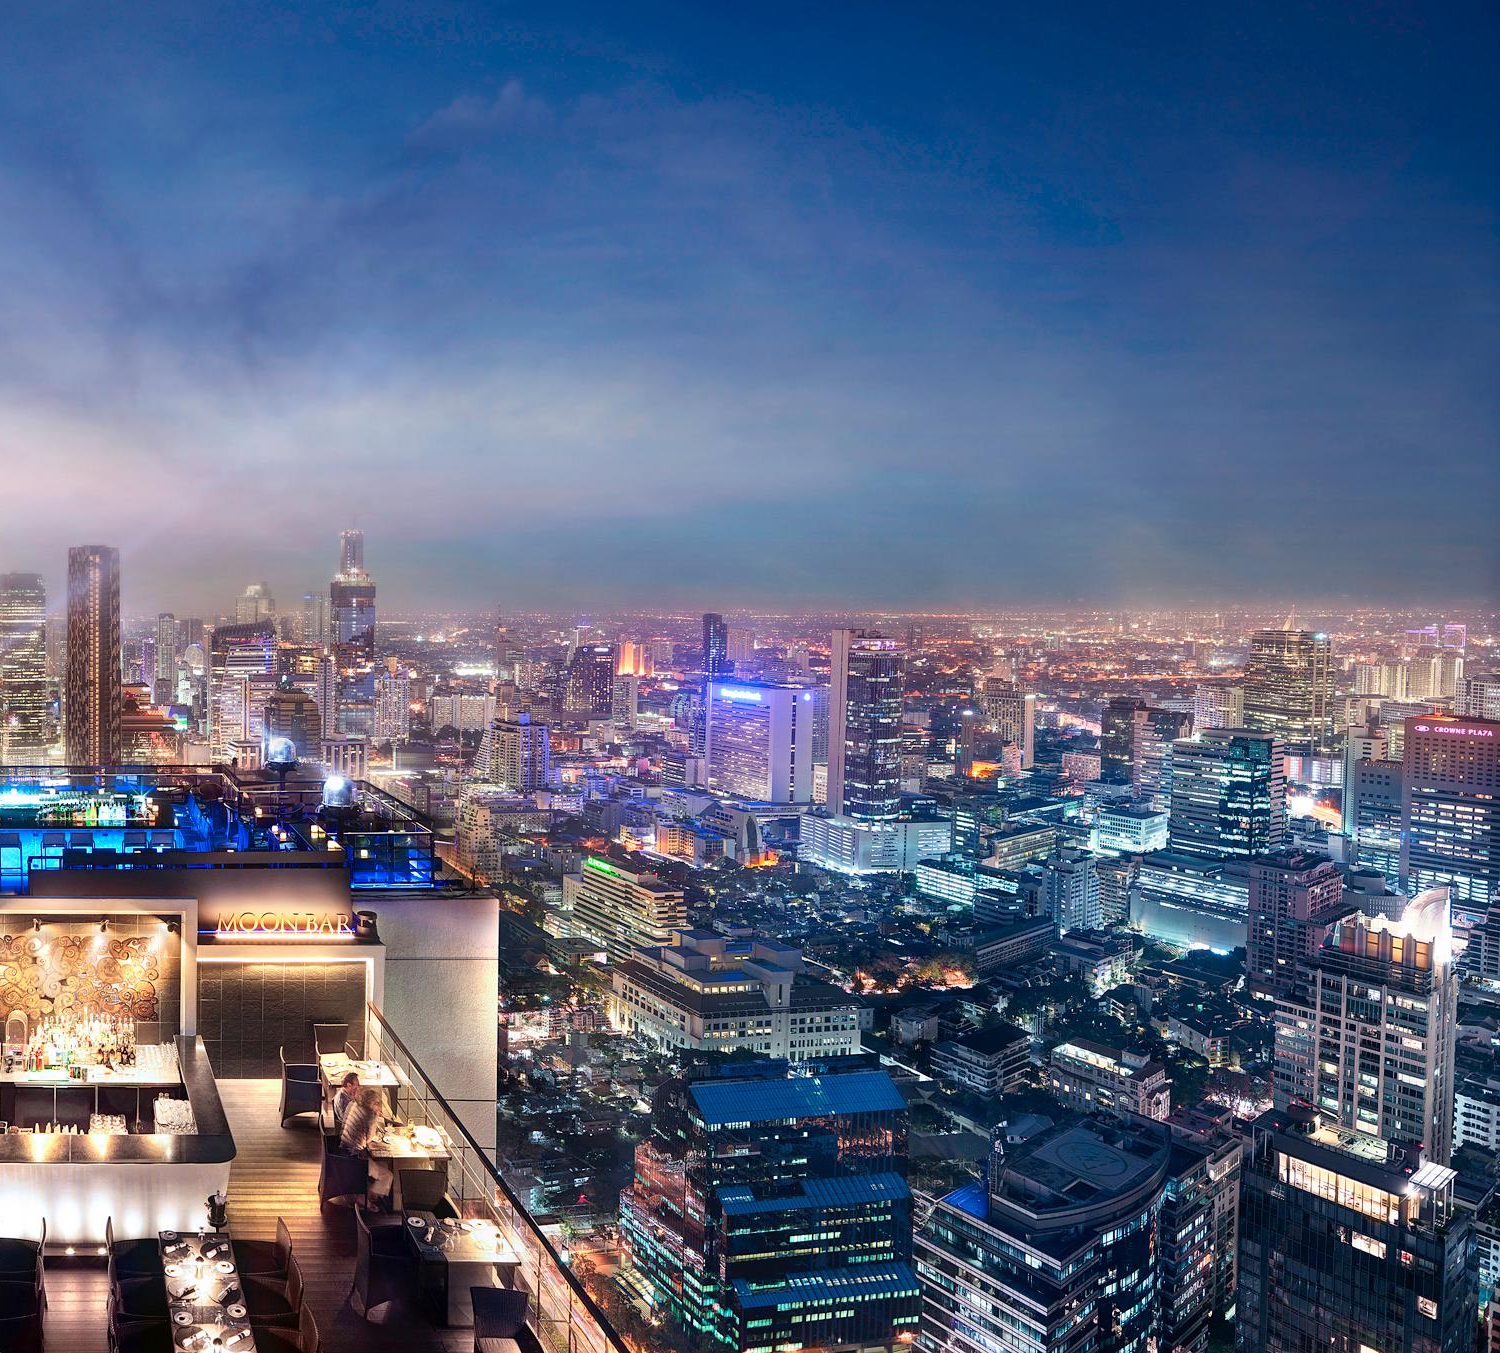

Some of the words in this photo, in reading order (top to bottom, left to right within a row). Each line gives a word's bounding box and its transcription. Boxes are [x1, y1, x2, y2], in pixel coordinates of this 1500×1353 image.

[1434, 726, 1466, 735] CROWNE
[1468, 728, 1493, 737] PLAZA
[216, 912, 299, 933] MOON
[305, 912, 353, 933] BAR
